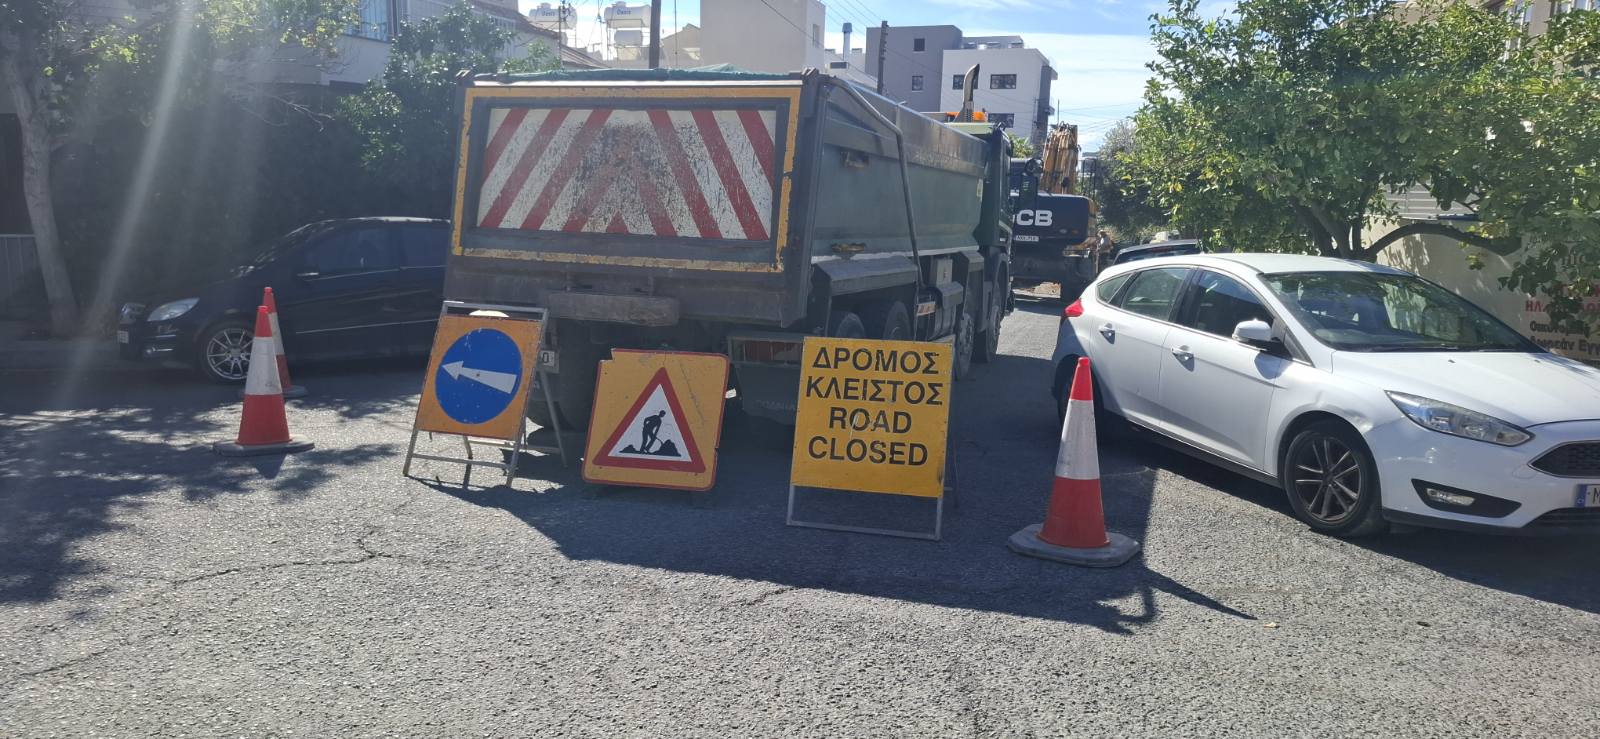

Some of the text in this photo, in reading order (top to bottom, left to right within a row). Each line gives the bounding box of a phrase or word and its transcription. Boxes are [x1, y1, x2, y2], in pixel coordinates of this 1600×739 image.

[812, 346, 940, 375] ΔΡΟΜΟΣ
[805, 375, 944, 405] ΚΛΕΙΣΤΟΣ
[829, 406, 912, 434] ROAD
[808, 435, 928, 466] CLOSED
